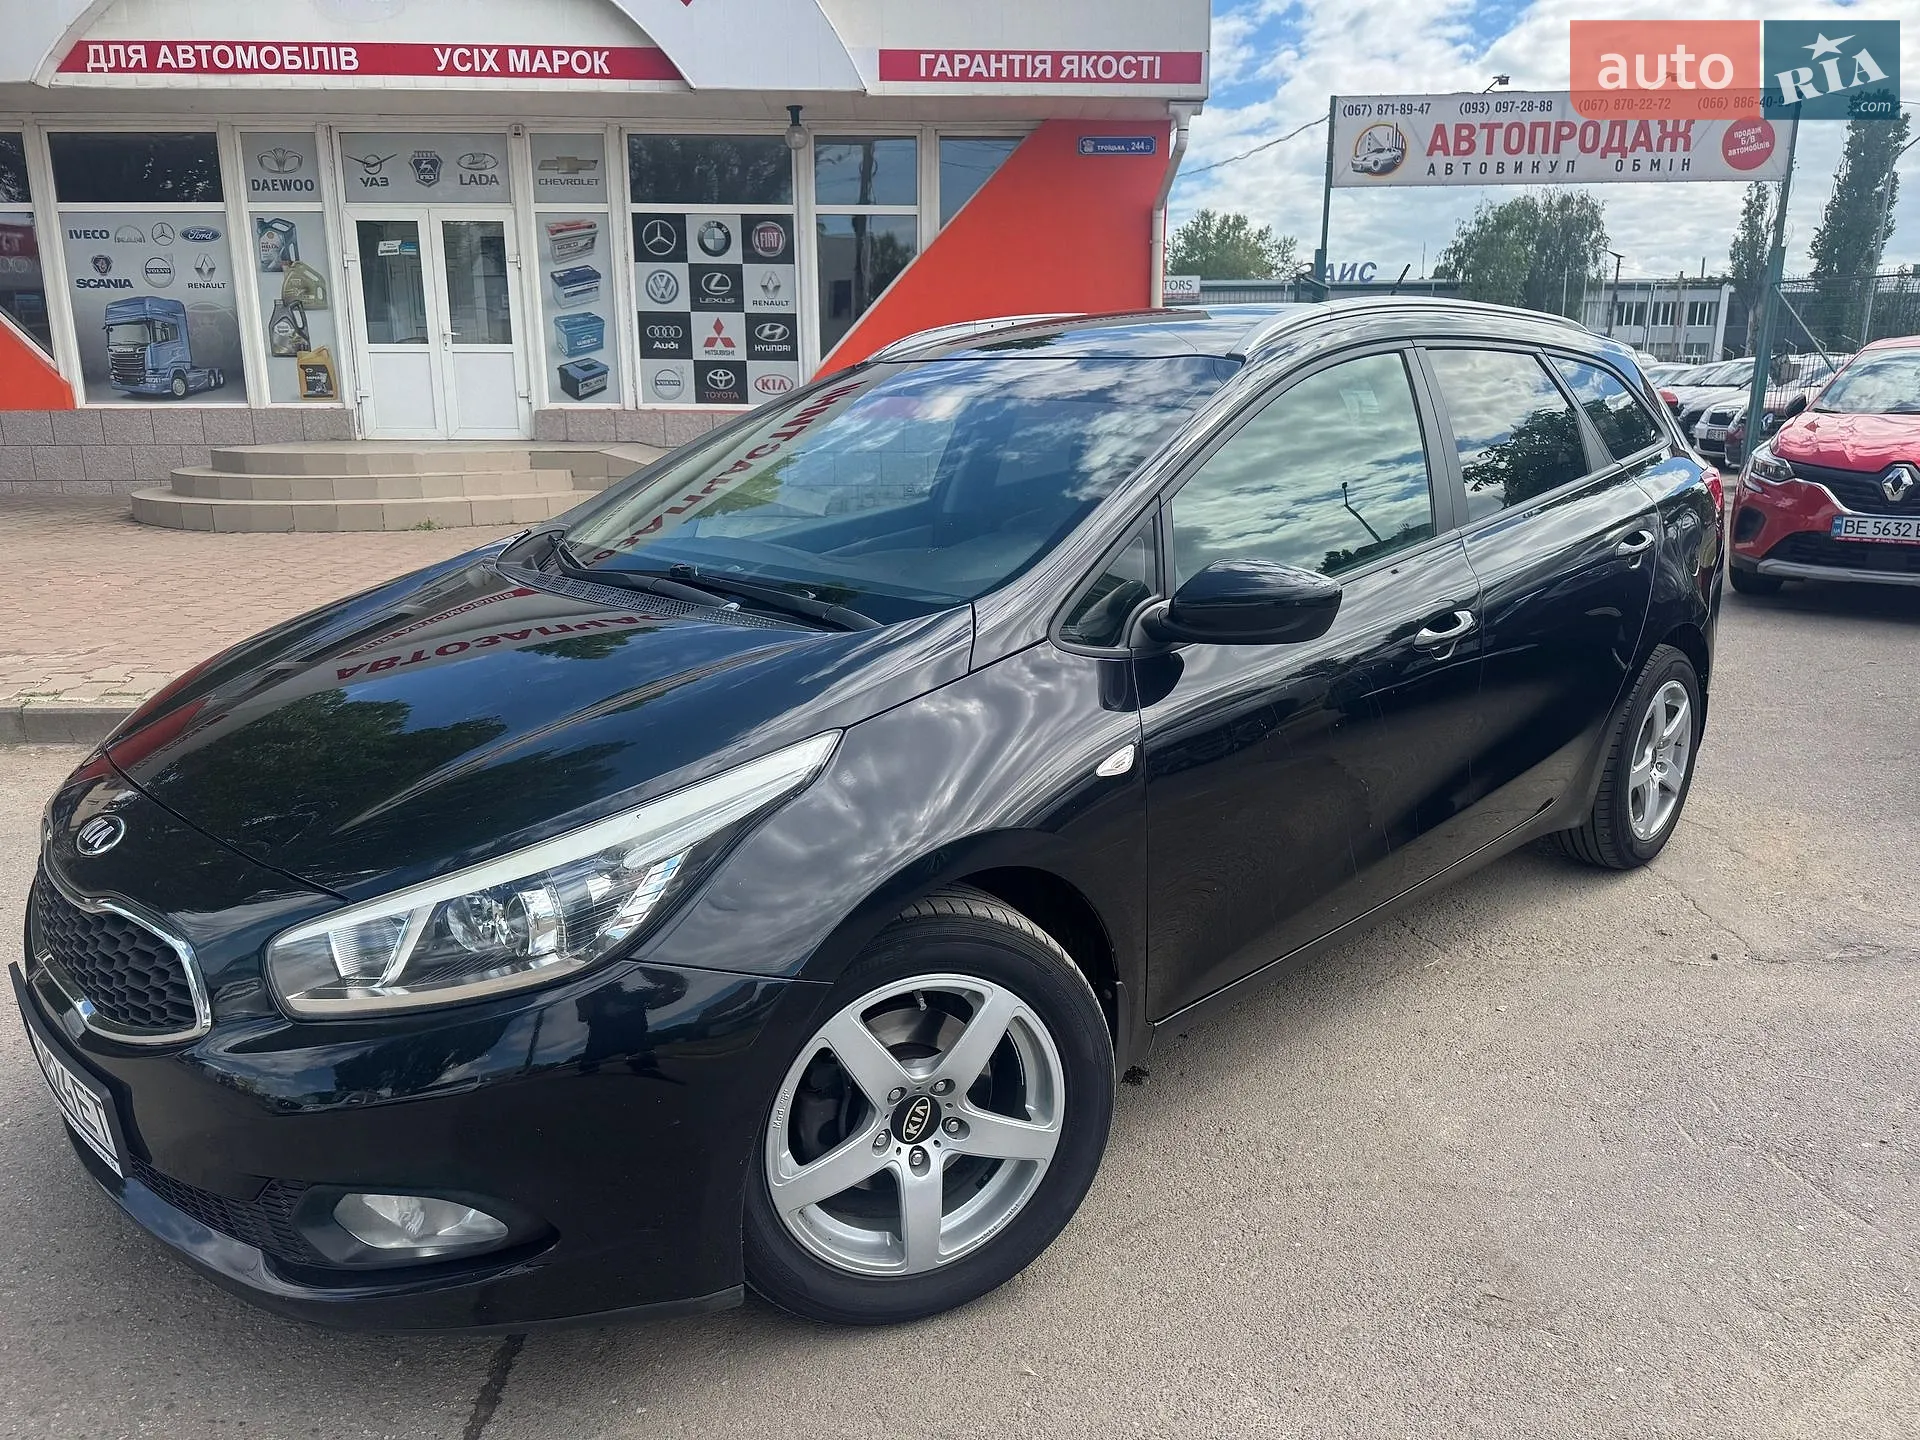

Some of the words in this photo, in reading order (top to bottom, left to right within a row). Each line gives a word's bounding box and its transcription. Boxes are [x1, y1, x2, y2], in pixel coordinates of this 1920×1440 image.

[87, 44, 148, 72] ДЛЯ
[156, 45, 359, 71] АВТОМОБІЛІВ
[433, 47, 500, 72] УСІХ
[508, 49, 611, 74] МАРОК
[920, 53, 1052, 78] ГАРАНТІЯ
[1060, 55, 1160, 79] ЯКОСТІ
[1342, 103, 1372, 117] (067)
[1377, 102, 1431, 115] 871-89-47
[1459, 101, 1490, 115] (093)
[1495, 100, 1553, 113] 097-28-88
[1578, 99, 1609, 112] (067)
[1613, 98, 1671, 110] 870-22-72
[1697, 97, 1728, 110] (066)
[1734, 95, 1791, 108] 886-40-9
[1426, 118, 1695, 159] АВТОПРОДАЖ
[1427, 160, 1575, 176] АВТОВИКУП
[1615, 158, 1691, 172] ОБМІН
[251, 178, 315, 192] DAEWOO
[459, 174, 499, 186] LADA
[538, 178, 600, 186] CHEVROLET
[68, 229, 110, 240] IVECO
[187, 229, 213, 240] Ford
[759, 231, 779, 248] FIAT
[75, 278, 134, 289] SCANIA
[653, 341, 679, 349] Audi
[754, 344, 791, 352] HYUNDAI
[761, 379, 787, 391] KIA
[705, 391, 740, 400] TOYOTA
[1844, 520, 1868, 535] BE
[1872, 522, 1912, 537] 5632
[906, 1105, 928, 1135] KIA
